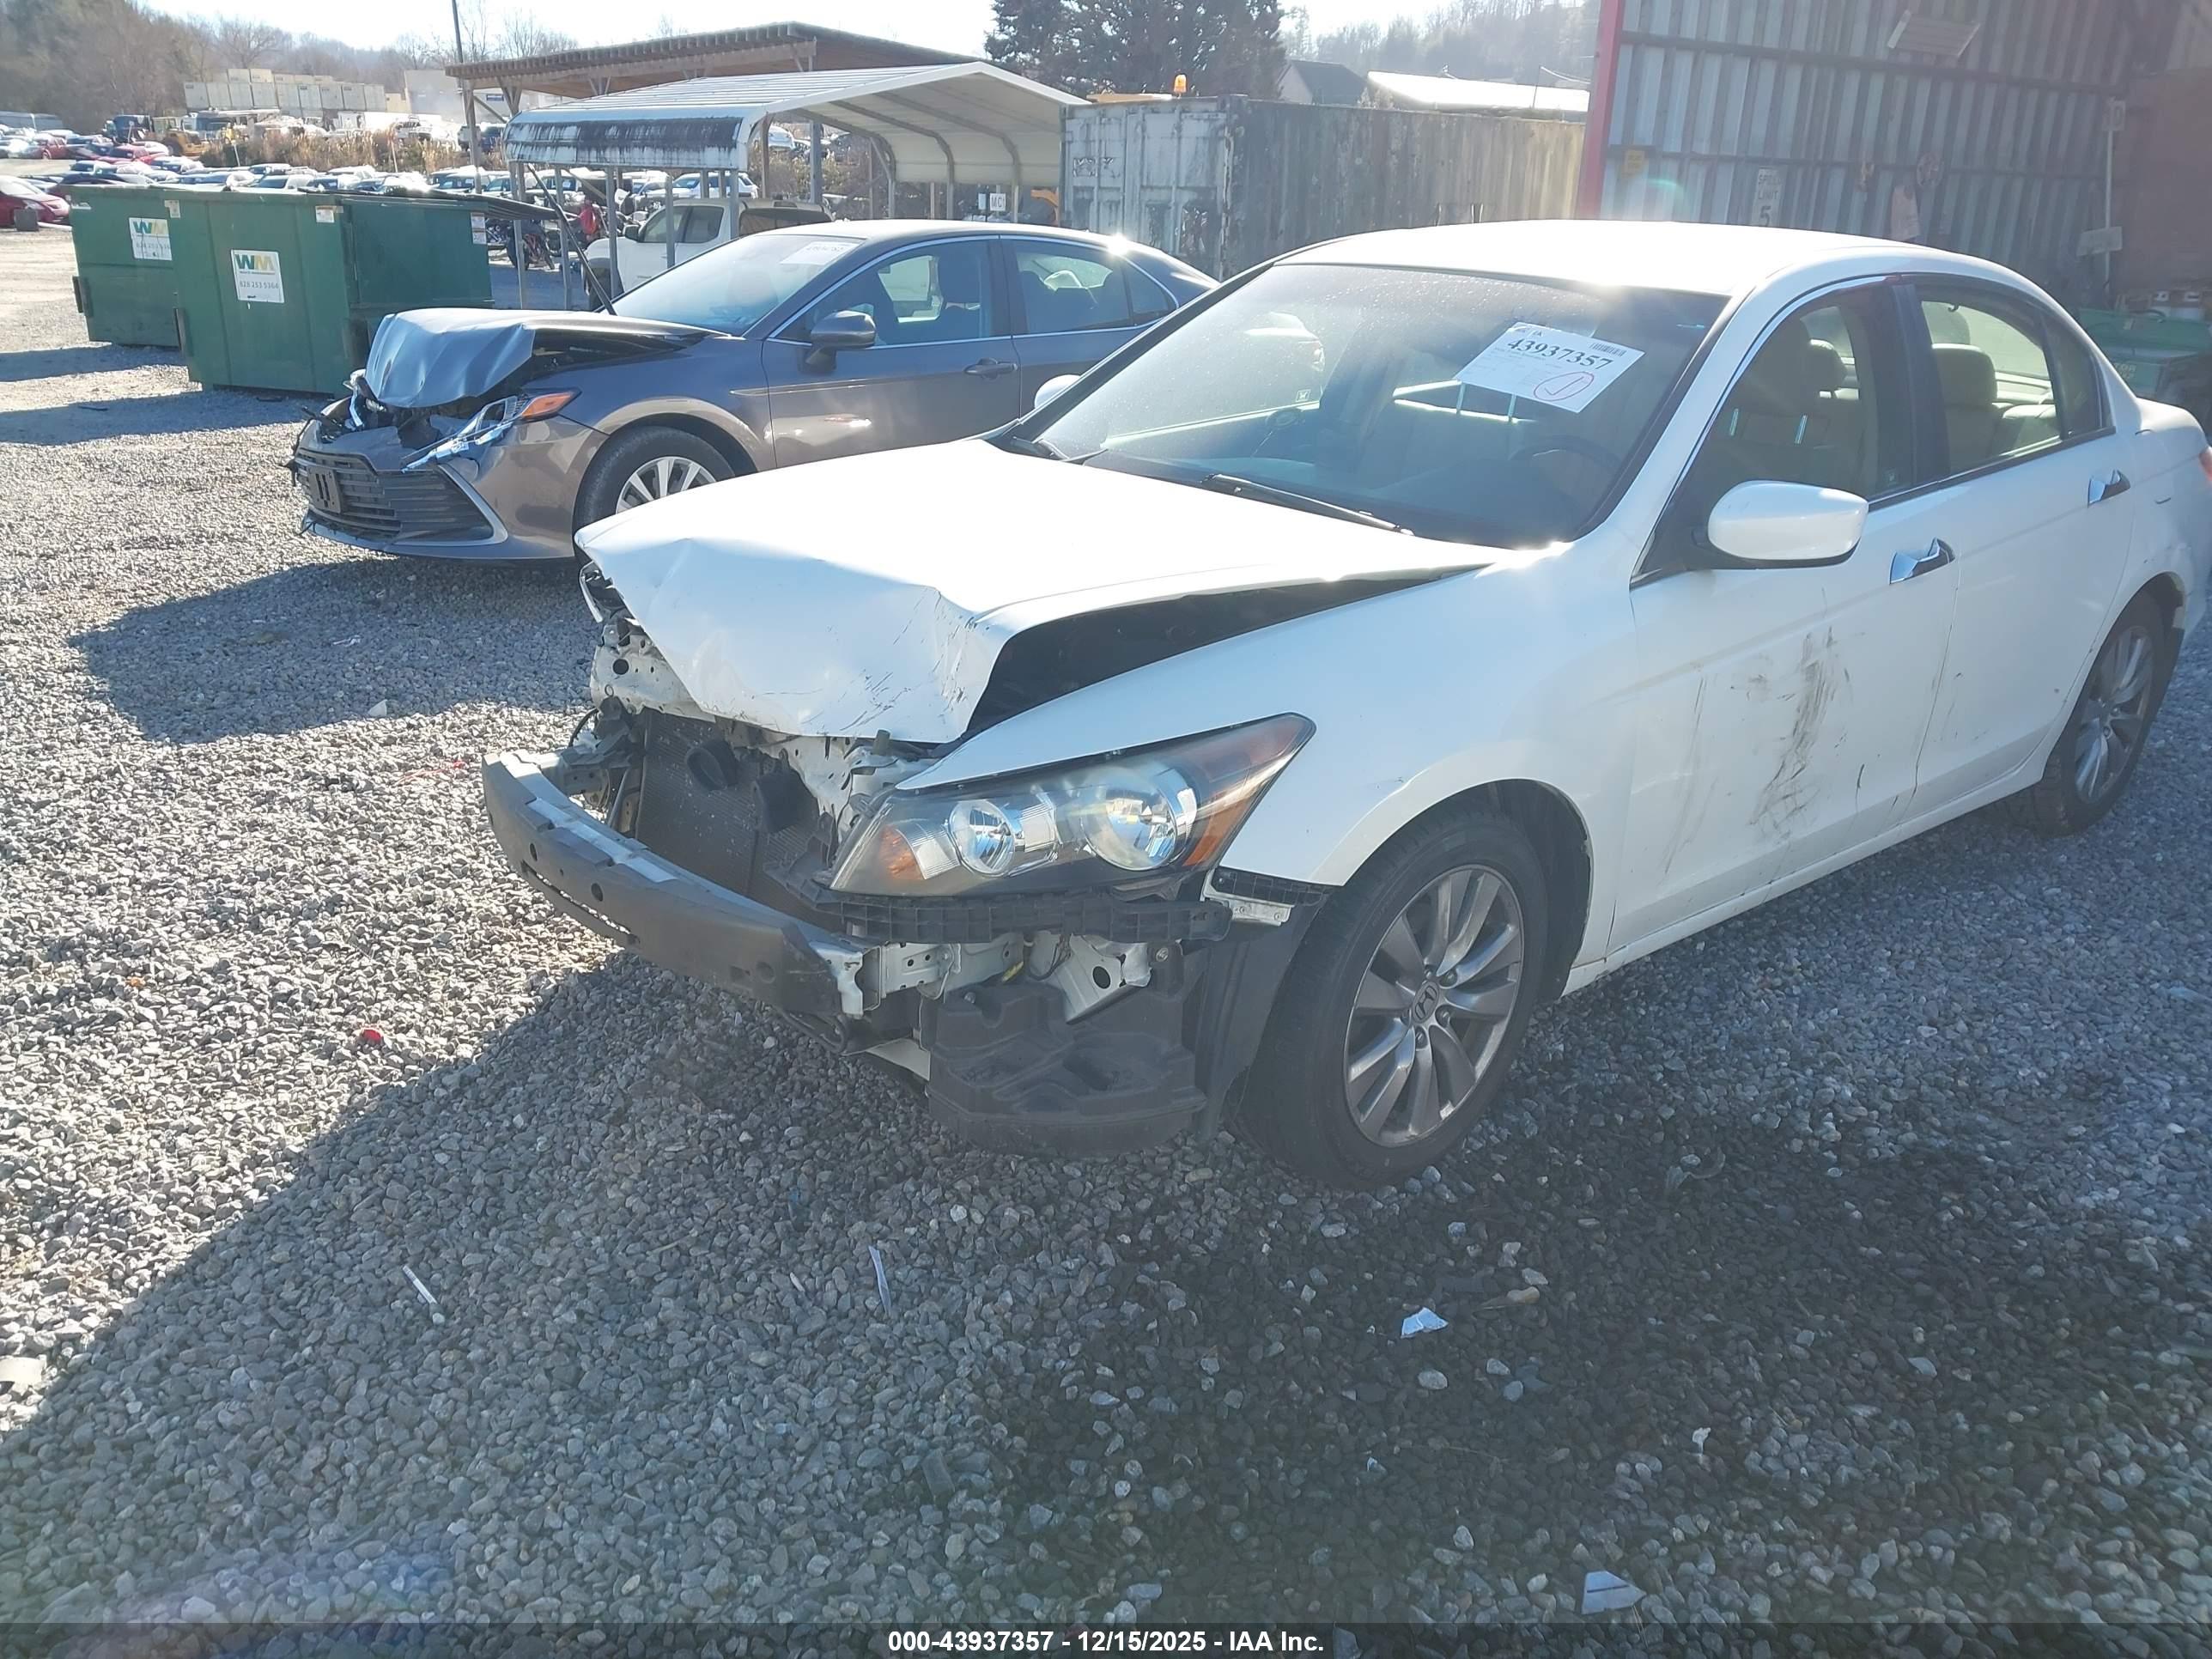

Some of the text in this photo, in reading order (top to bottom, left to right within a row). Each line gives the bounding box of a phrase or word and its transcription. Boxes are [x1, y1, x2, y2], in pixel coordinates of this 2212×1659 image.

[1758, 190, 1778, 200] LIMIT
[234, 254, 275, 270] WM
[1507, 338, 1613, 370] 43937357
